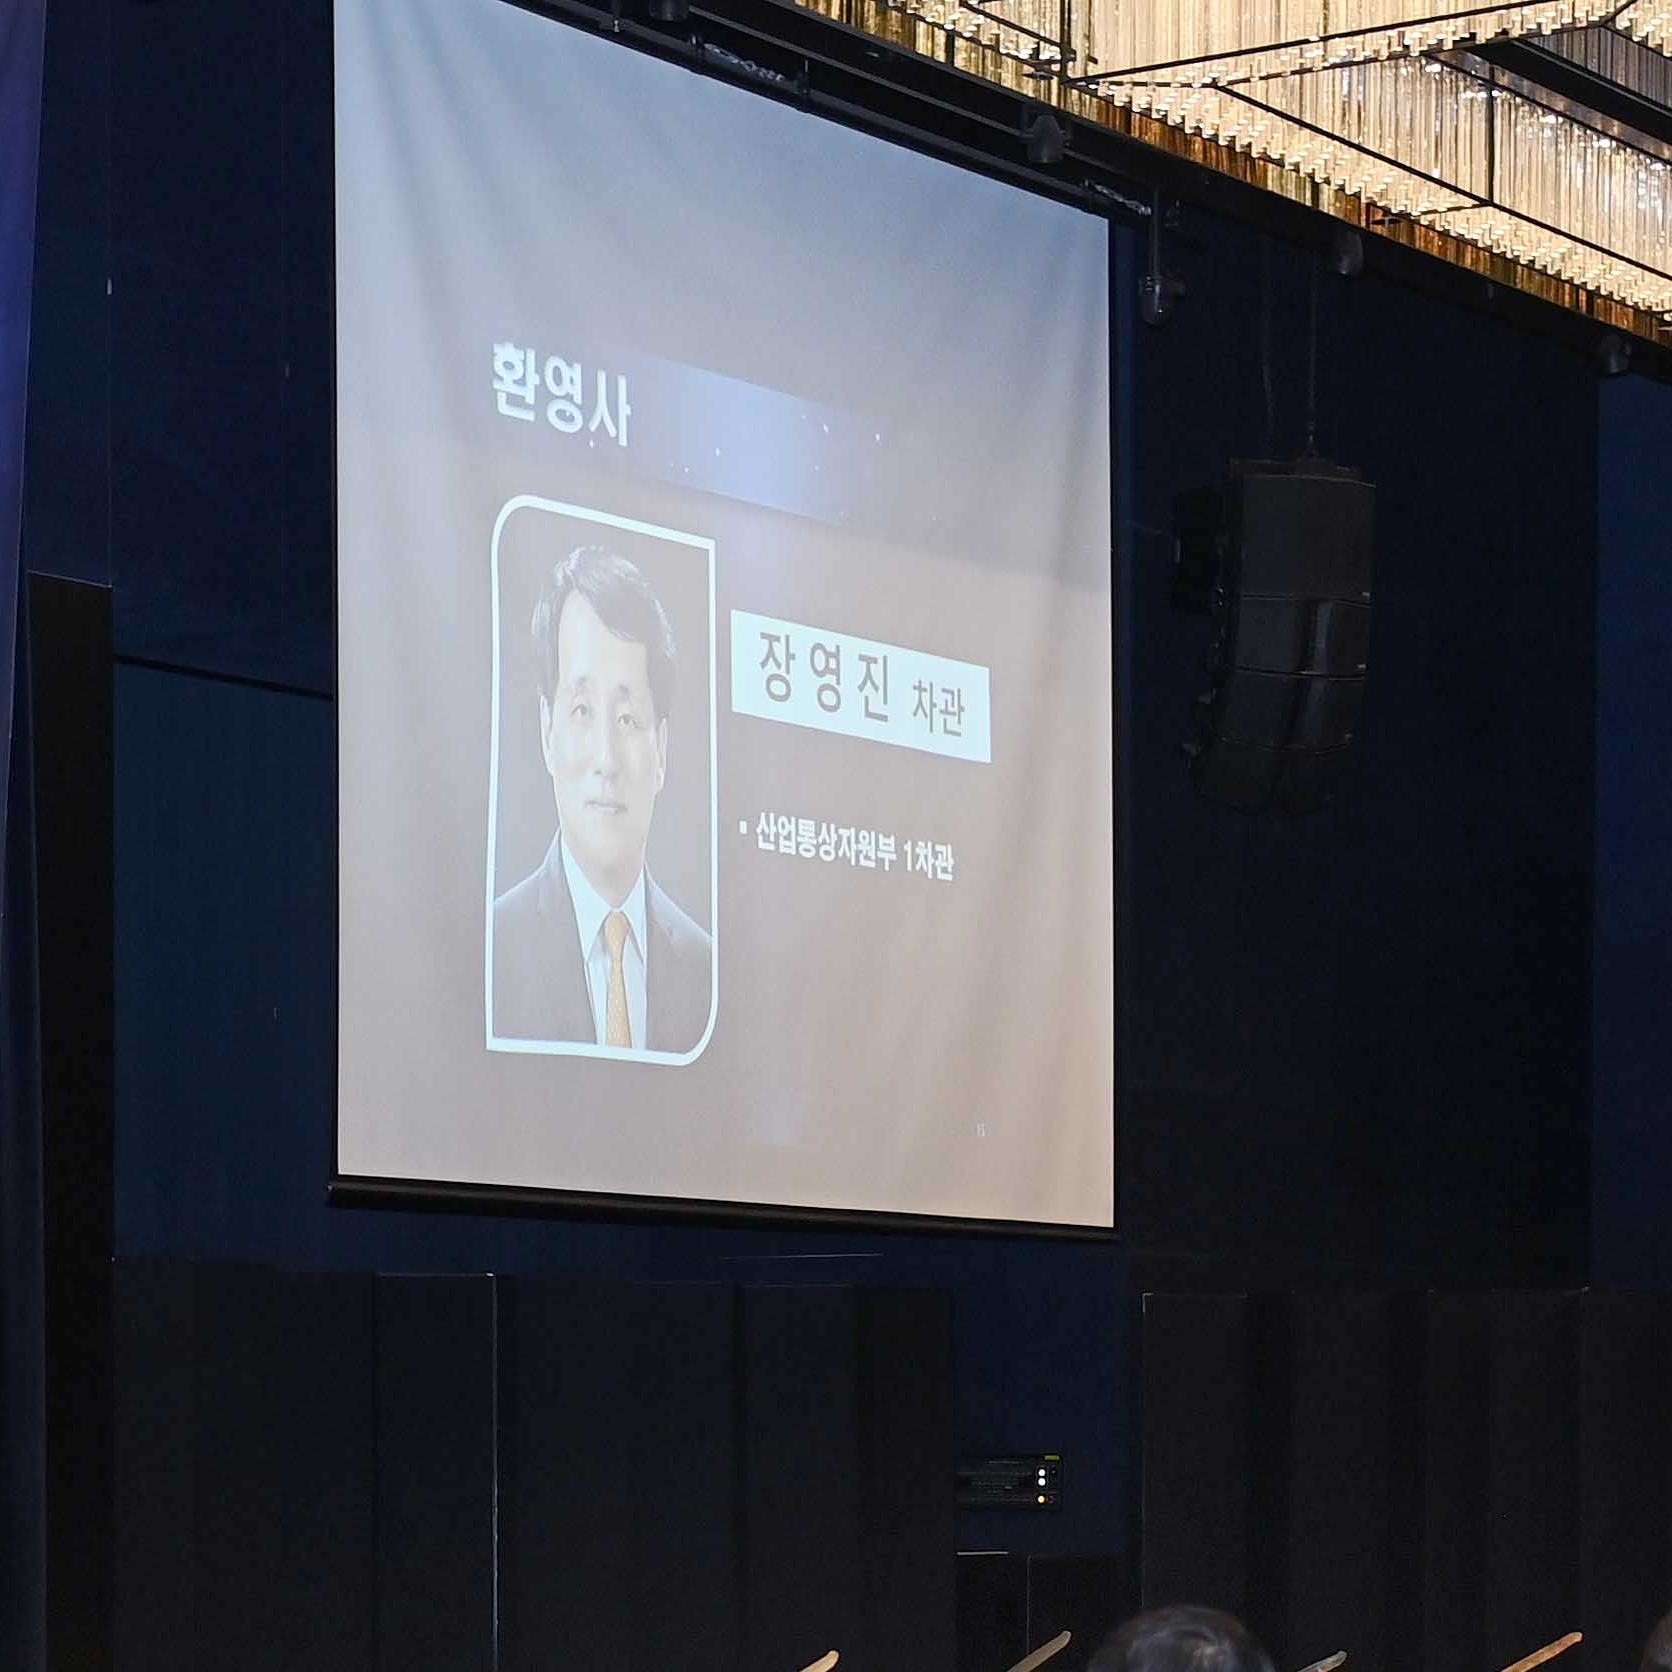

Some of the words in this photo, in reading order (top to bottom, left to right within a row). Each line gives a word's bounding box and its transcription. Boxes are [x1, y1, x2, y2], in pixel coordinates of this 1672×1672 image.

[492, 342, 633, 447] 환영사
[912, 679, 966, 737] 차관
[756, 811, 898, 872] 산업통상자원부
[903, 840, 955, 881] 1차관
